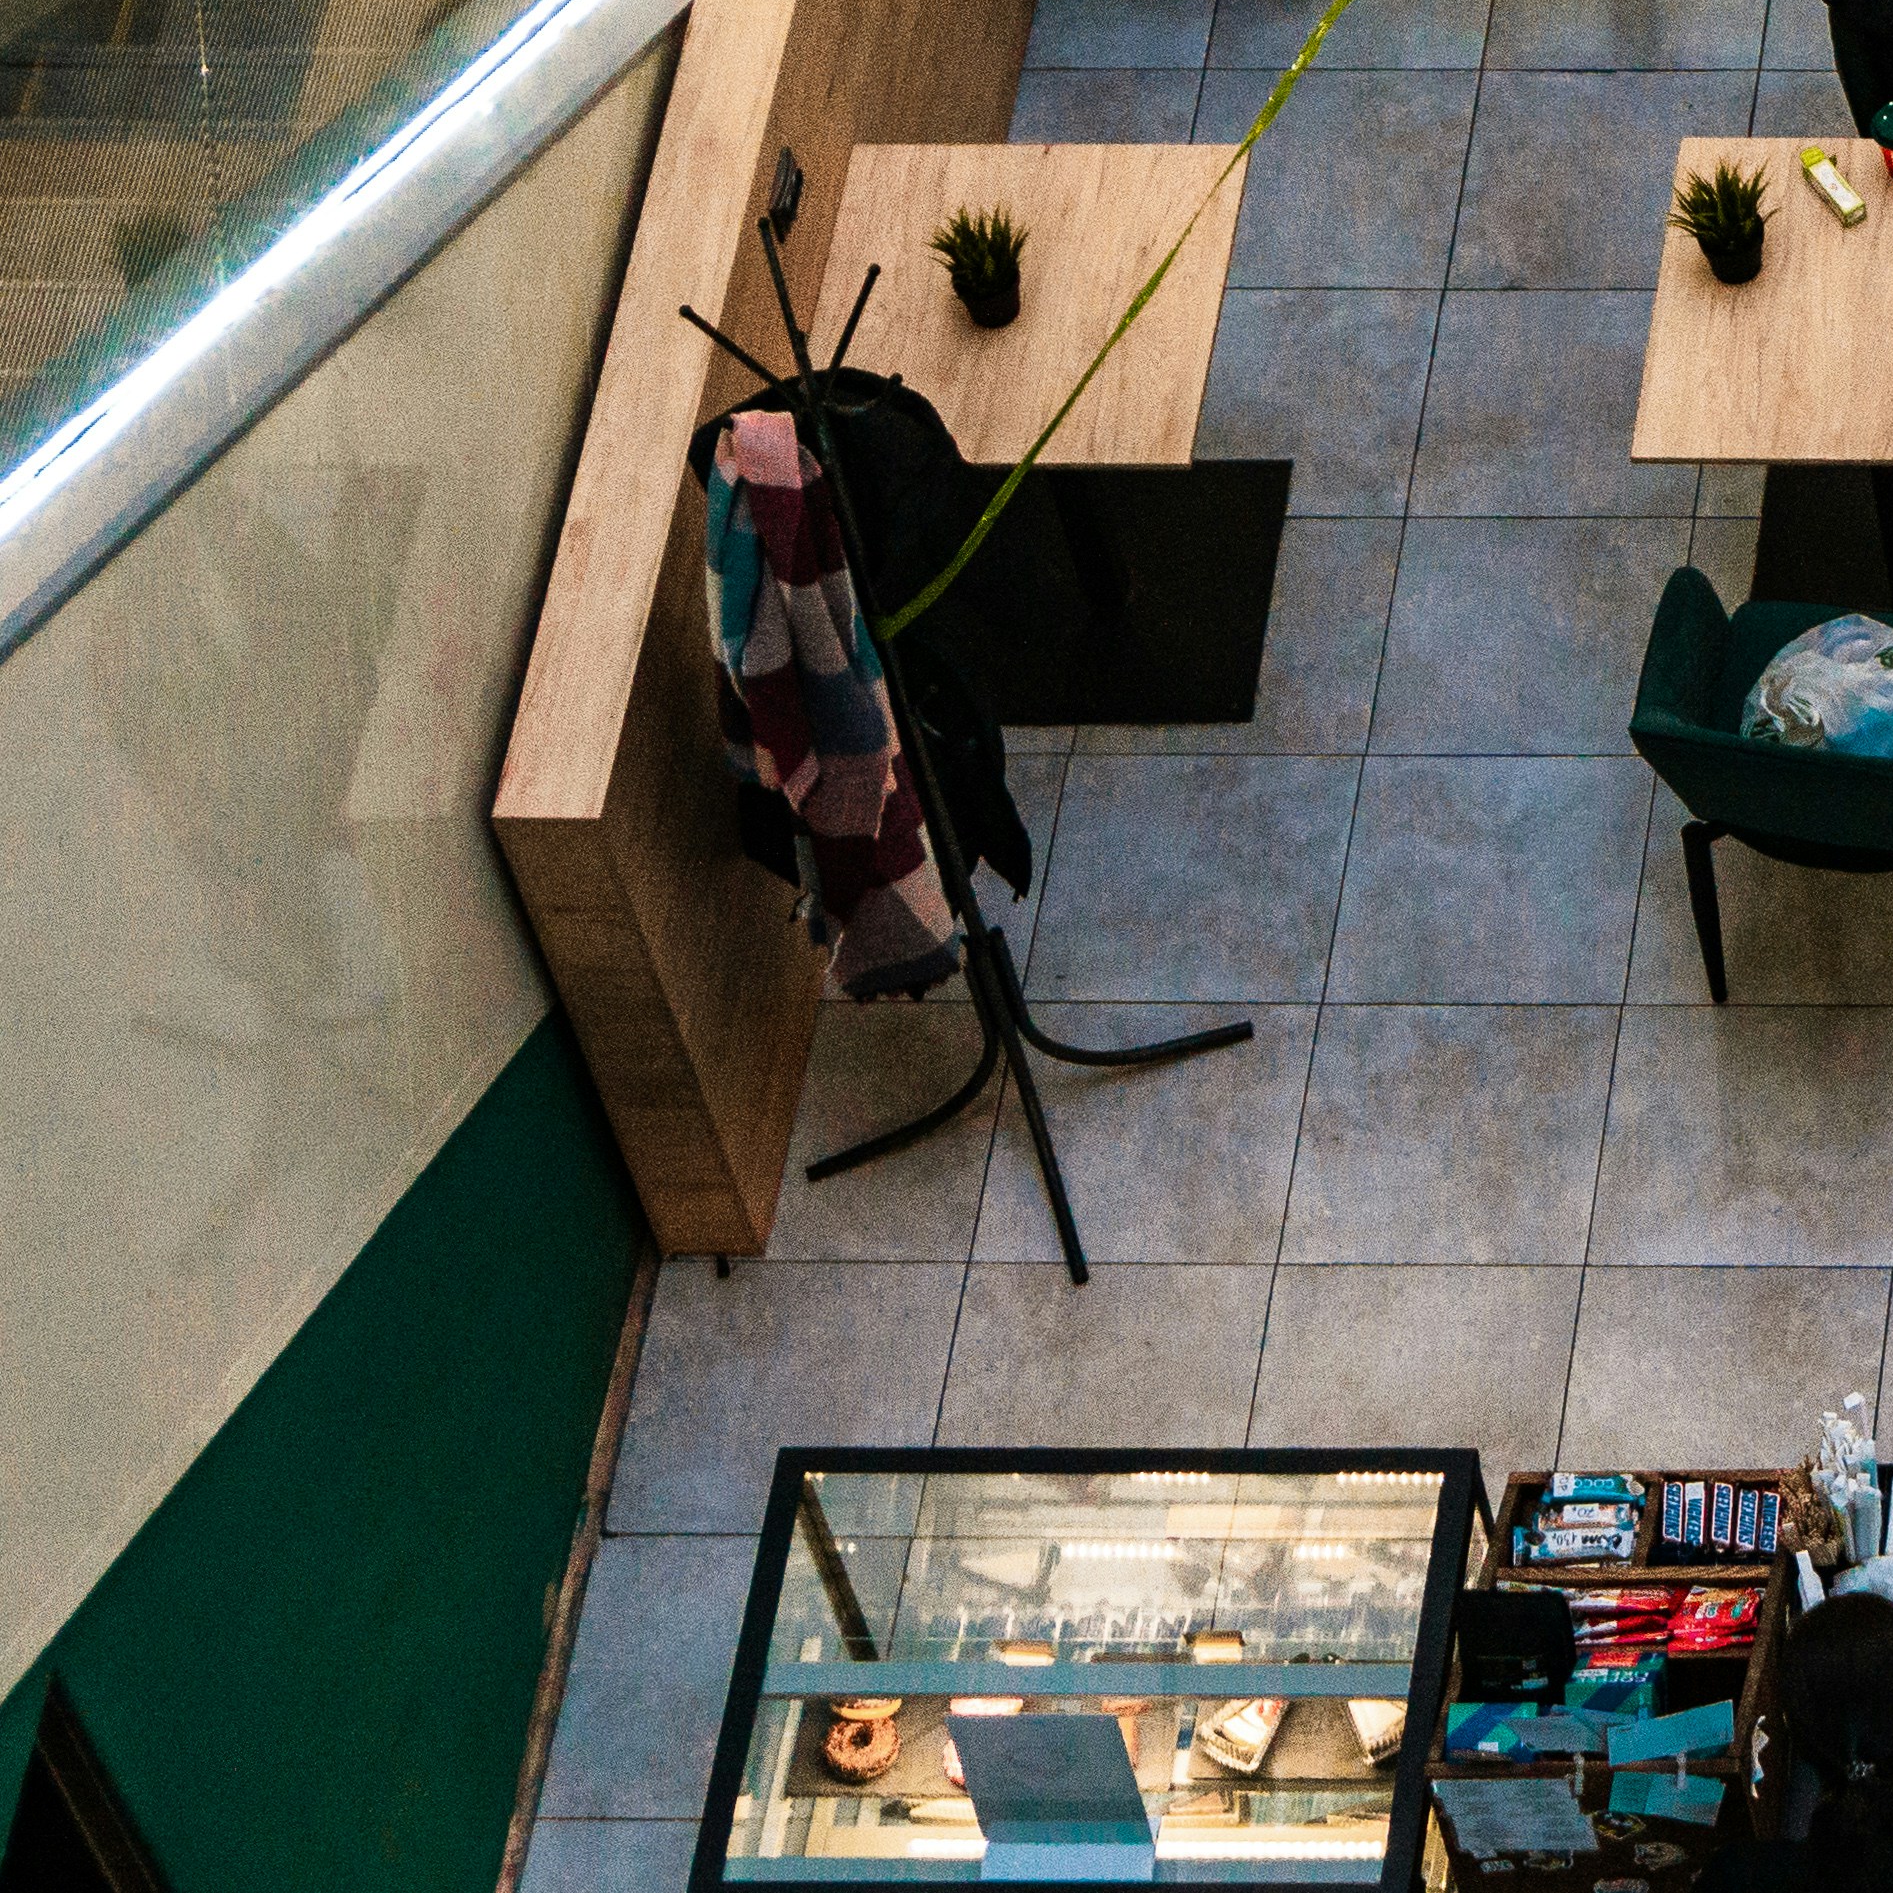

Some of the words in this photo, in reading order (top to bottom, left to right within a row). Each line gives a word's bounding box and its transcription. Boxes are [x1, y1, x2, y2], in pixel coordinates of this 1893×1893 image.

[1664, 1483, 1681, 1539] SNICKERS
[1713, 1484, 1731, 1540] SNICKERS
[1738, 1489, 1757, 1546] SNICKERS
[1759, 1494, 1778, 1551] SNICKERS
